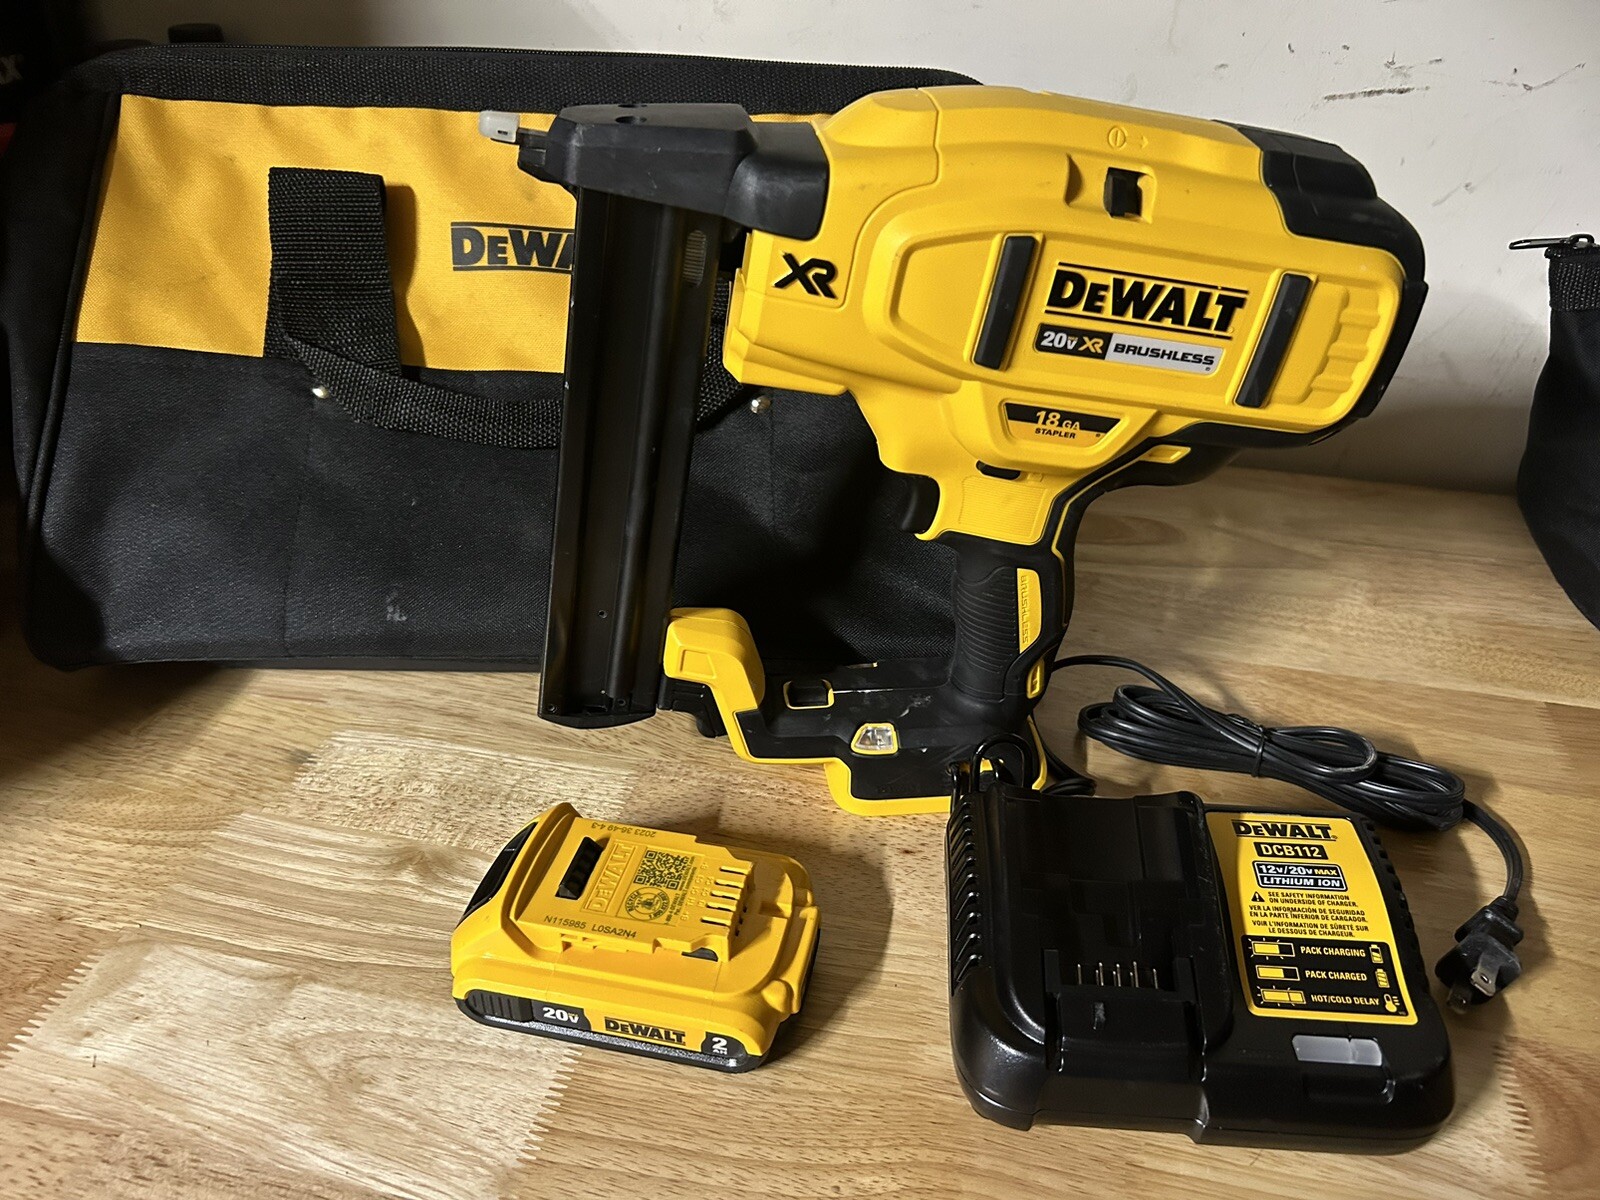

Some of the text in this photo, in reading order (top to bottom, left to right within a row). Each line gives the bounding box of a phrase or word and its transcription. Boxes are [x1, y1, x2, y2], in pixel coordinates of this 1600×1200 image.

[774, 252, 838, 299] XR
[1078, 336, 1104, 353] XR
[1113, 343, 1215, 366] BRUSHLESS
[1036, 410, 1080, 430] 18 GA
[1035, 427, 1076, 439] STAPLER
[1020, 575, 1029, 643] BRUSHLESS
[634, 829, 656, 838] 2023
[1260, 844, 1322, 857] DCB112
[1314, 868, 1338, 876] MAX
[1263, 876, 1341, 888] LITHIUM ION
[544, 915, 587, 929] N115985
[1269, 920, 1319, 929] L'INFORMATION
[1300, 946, 1366, 957] PACK CHARGING
[1305, 970, 1368, 981] PACK CHARGED
[1311, 994, 1380, 1005] HOT/COLD DELAY
[712, 1036, 728, 1050] 2
